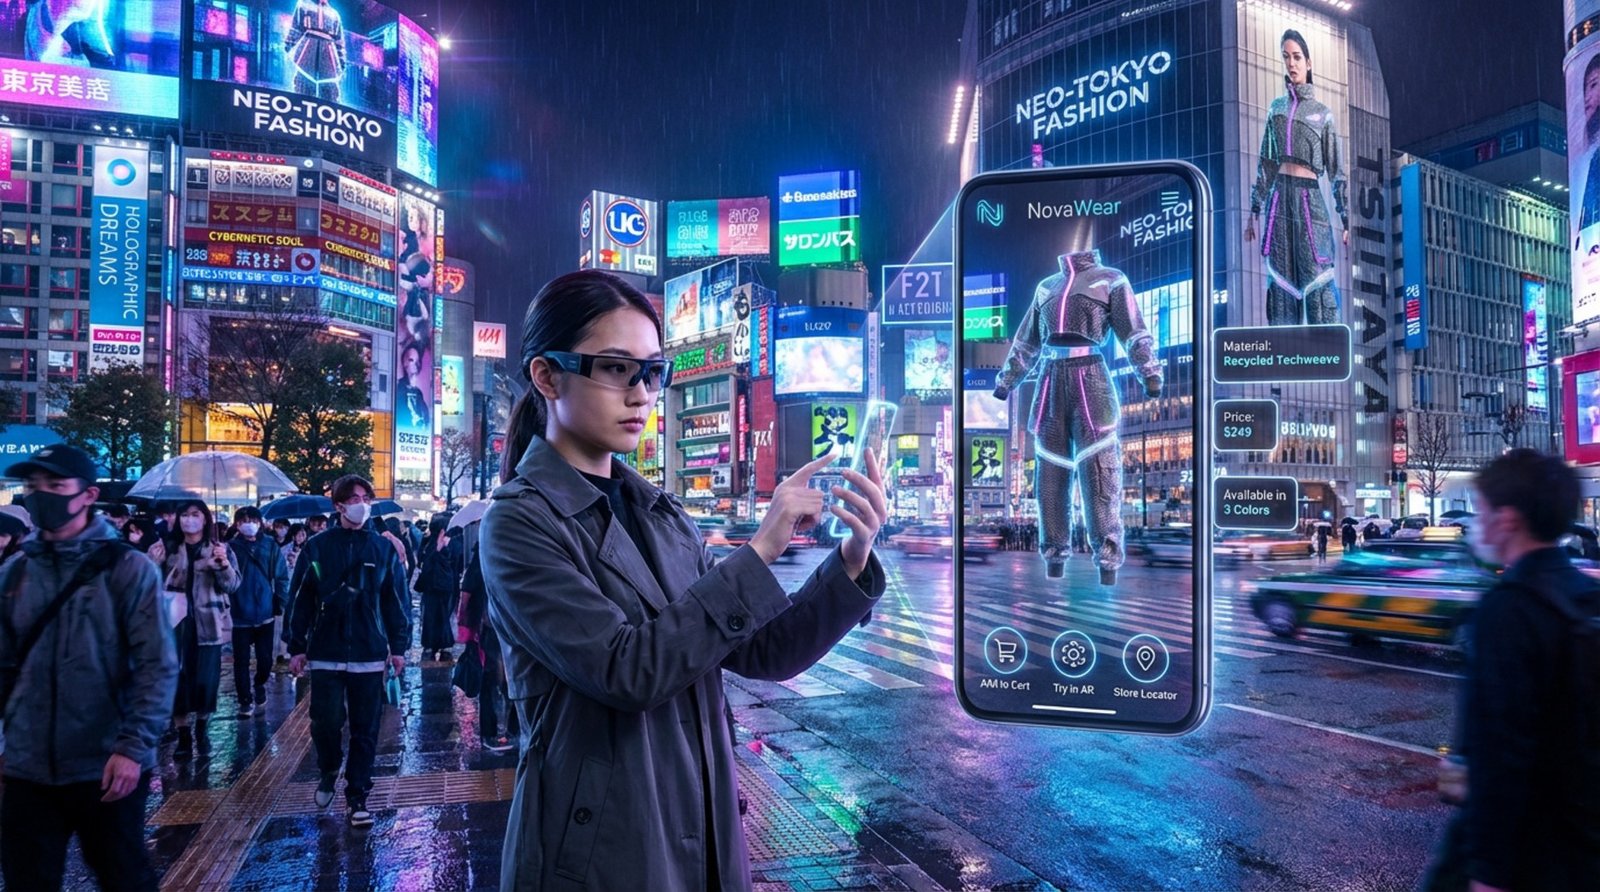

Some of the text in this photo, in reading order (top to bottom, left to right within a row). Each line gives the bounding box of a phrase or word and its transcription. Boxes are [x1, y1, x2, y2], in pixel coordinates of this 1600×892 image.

[1015, 50, 1171, 125] NEO-TOKYO
[233, 88, 382, 138] NEO-TOKYO
[1033, 80, 1149, 140] FASHION
[253, 112, 365, 152] FASHION
[1028, 199, 1121, 219] NovaWear
[99, 202, 119, 286] DREAMS
[208, 230, 274, 245] CYBERNETIC
[123, 205, 140, 320] HOLOGRAPHIC
[901, 271, 942, 298] F2T
[1223, 340, 1272, 352] Material:
[1223, 355, 1274, 368] Recycled
[1223, 411, 1255, 423] Price:
[1223, 425, 1252, 438] $249
[1276, 489, 1287, 501] in
[1223, 503, 1270, 516] 3 Colors
[1053, 682, 1095, 696] Try in AR
[1140, 689, 1178, 700] Locator
